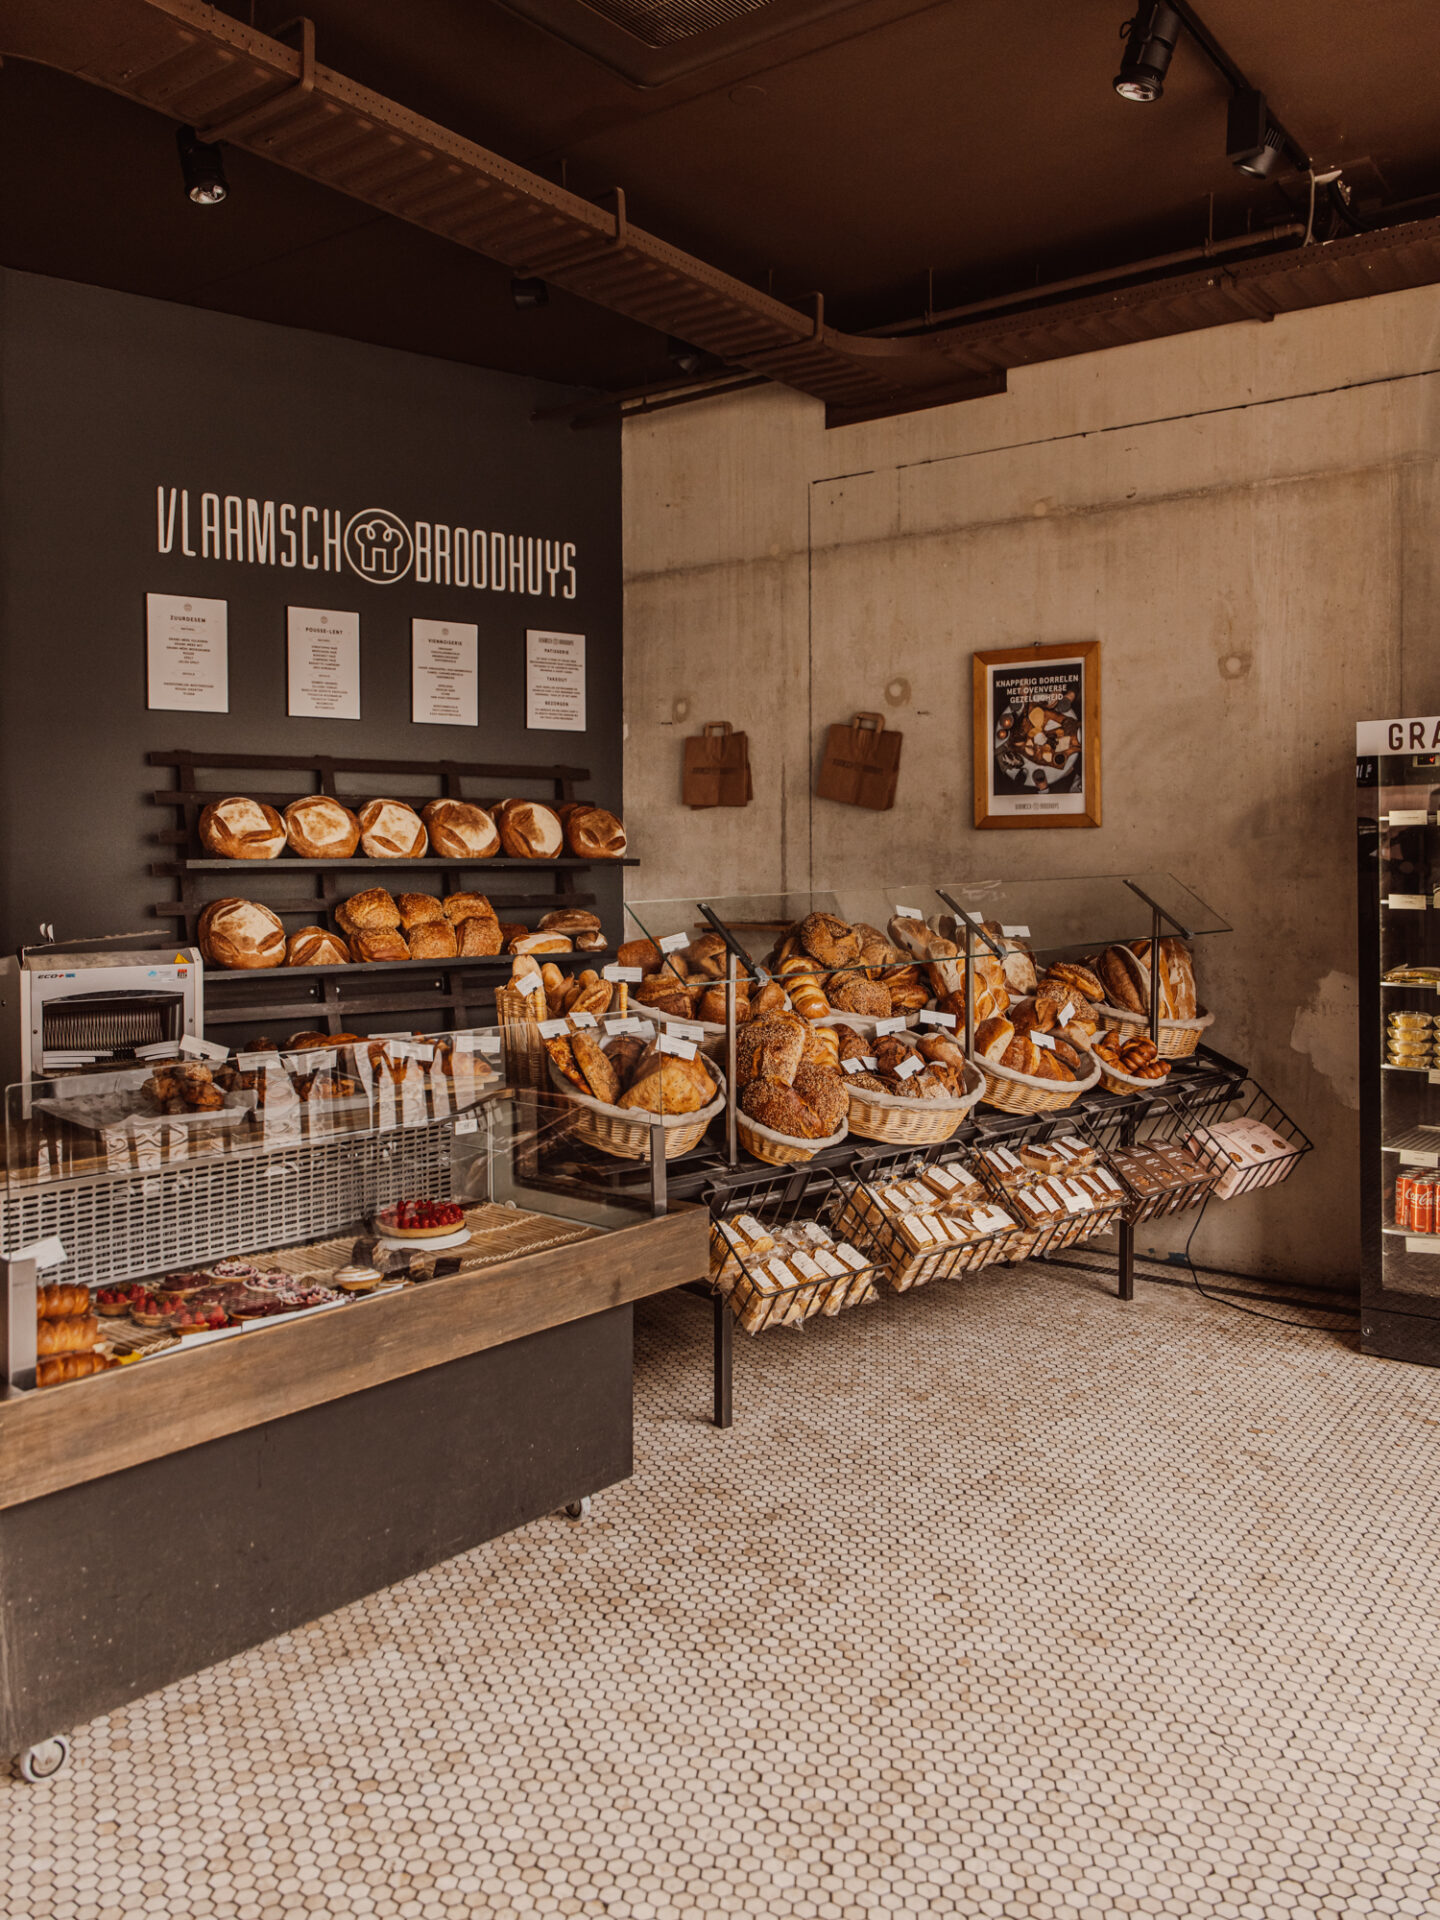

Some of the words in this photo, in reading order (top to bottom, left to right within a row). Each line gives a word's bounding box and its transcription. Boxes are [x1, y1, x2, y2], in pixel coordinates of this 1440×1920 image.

[157, 485, 342, 572] VLAAMSCH
[415, 520, 577, 600] BROODHUYS
[305, 627, 343, 635] POUSSE-LENT
[995, 678, 1037, 687] KNAPPERIG
[1039, 674, 1079, 684] BORRELEN
[1023, 684, 1067, 693] OVENVERSE
[1010, 693, 1063, 703] GEZELLIGHEID
